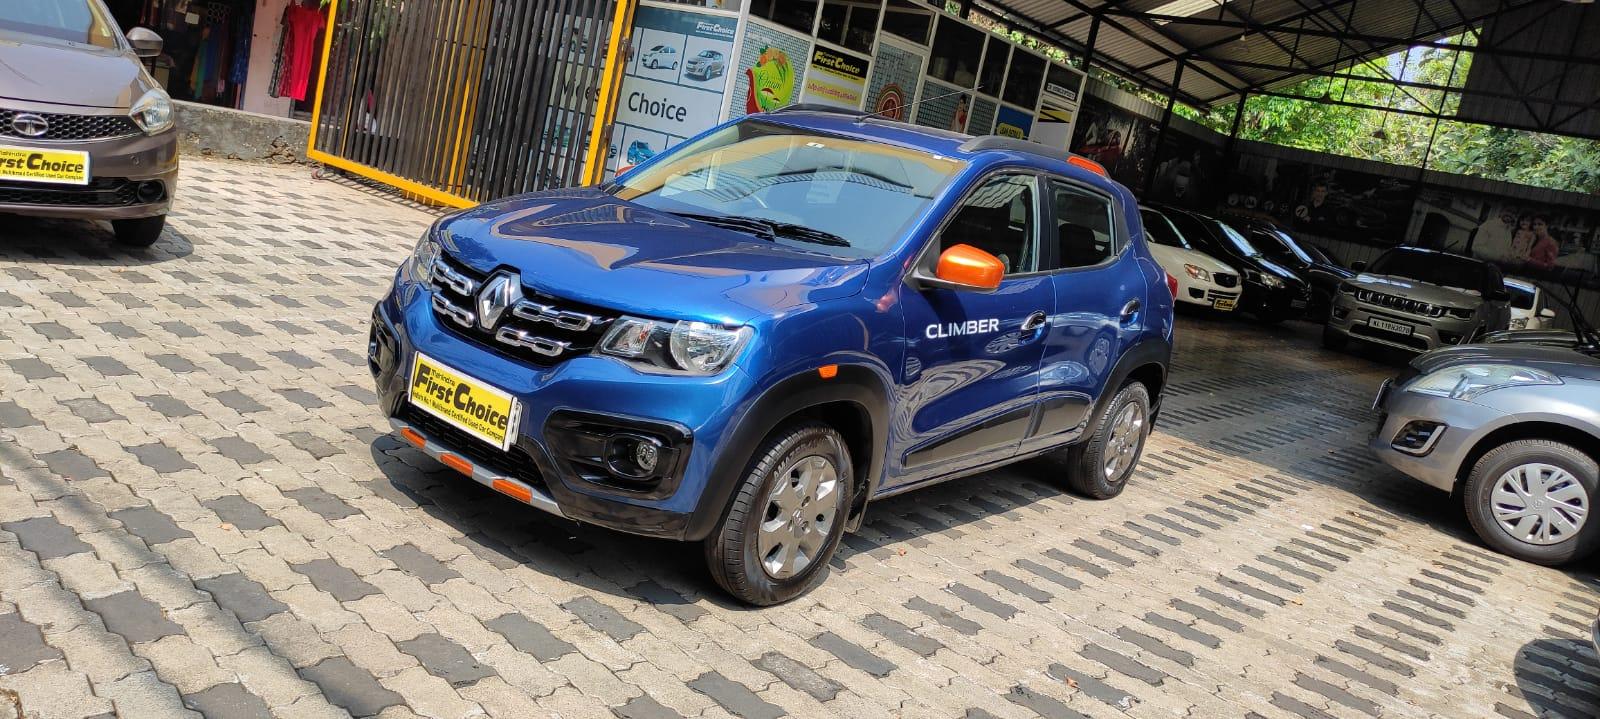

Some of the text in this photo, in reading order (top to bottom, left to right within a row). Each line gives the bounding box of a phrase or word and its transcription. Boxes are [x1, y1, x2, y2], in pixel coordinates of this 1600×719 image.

[628, 91, 687, 123] Choice
[0, 157, 25, 169] rst
[926, 318, 1000, 339] CLIMBER
